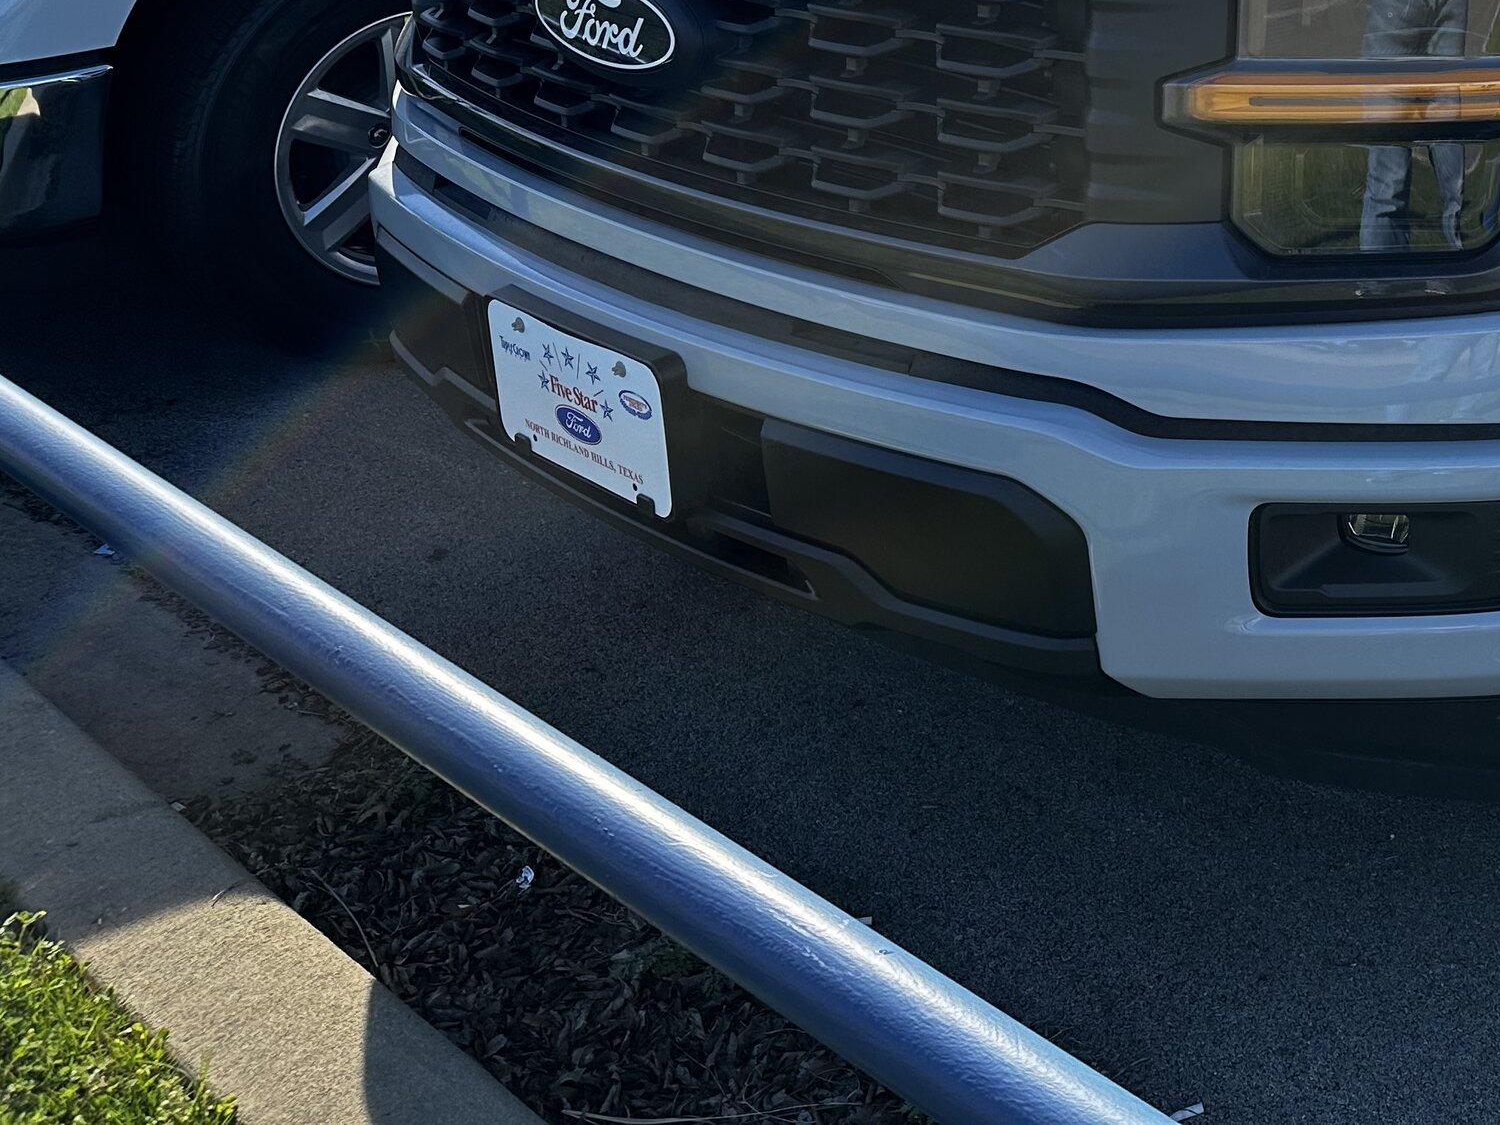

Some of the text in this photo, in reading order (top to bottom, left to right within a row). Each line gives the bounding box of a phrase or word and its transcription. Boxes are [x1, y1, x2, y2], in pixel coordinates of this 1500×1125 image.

[549, 374, 573, 402] Five
[573, 386, 598, 413] Star
[565, 411, 592, 439] Ford
[524, 418, 644, 485] NORTH RICHLAND HILLS, TEXAS
